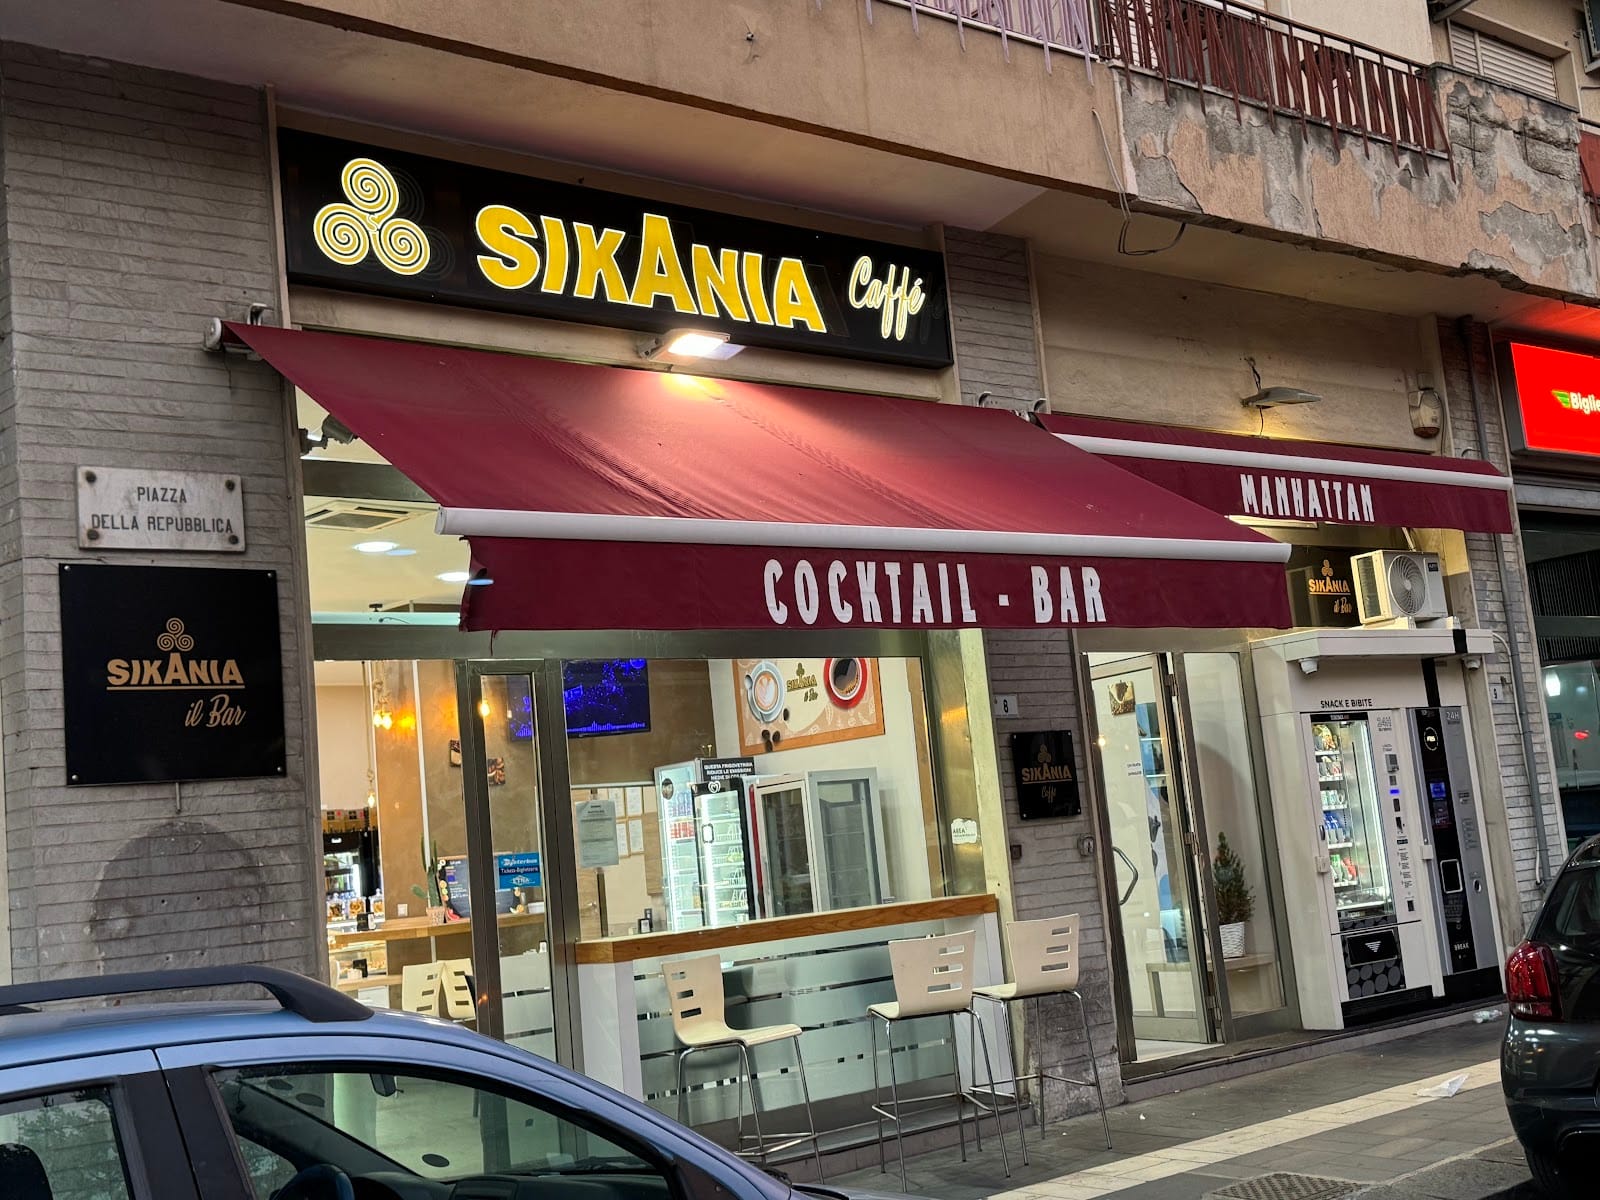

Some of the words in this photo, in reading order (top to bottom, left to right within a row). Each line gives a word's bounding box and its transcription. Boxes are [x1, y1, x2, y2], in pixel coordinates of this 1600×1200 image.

[475, 204, 827, 333] SIKANIA
[848, 255, 926, 341] Caffé
[137, 487, 187, 503] PIAZZA
[1240, 473, 1375, 522] MANHATTAN
[92, 514, 139, 530] DELLA
[147, 515, 234, 534] REPUBBLICA
[763, 558, 977, 625] COCKTAIL
[1030, 565, 1107, 624] BAR
[1308, 576, 1350, 593] SIKANIA
[107, 652, 244, 685] SIKANIA
[185, 699, 204, 727] il
[206, 694, 246, 728] Bar
[1003, 699, 1009, 713] 8
[1320, 700, 1344, 708] SNACK
[1345, 699, 1350, 707] E
[1351, 698, 1373, 707] BIBITE
[1022, 763, 1072, 782] SIKANIA
